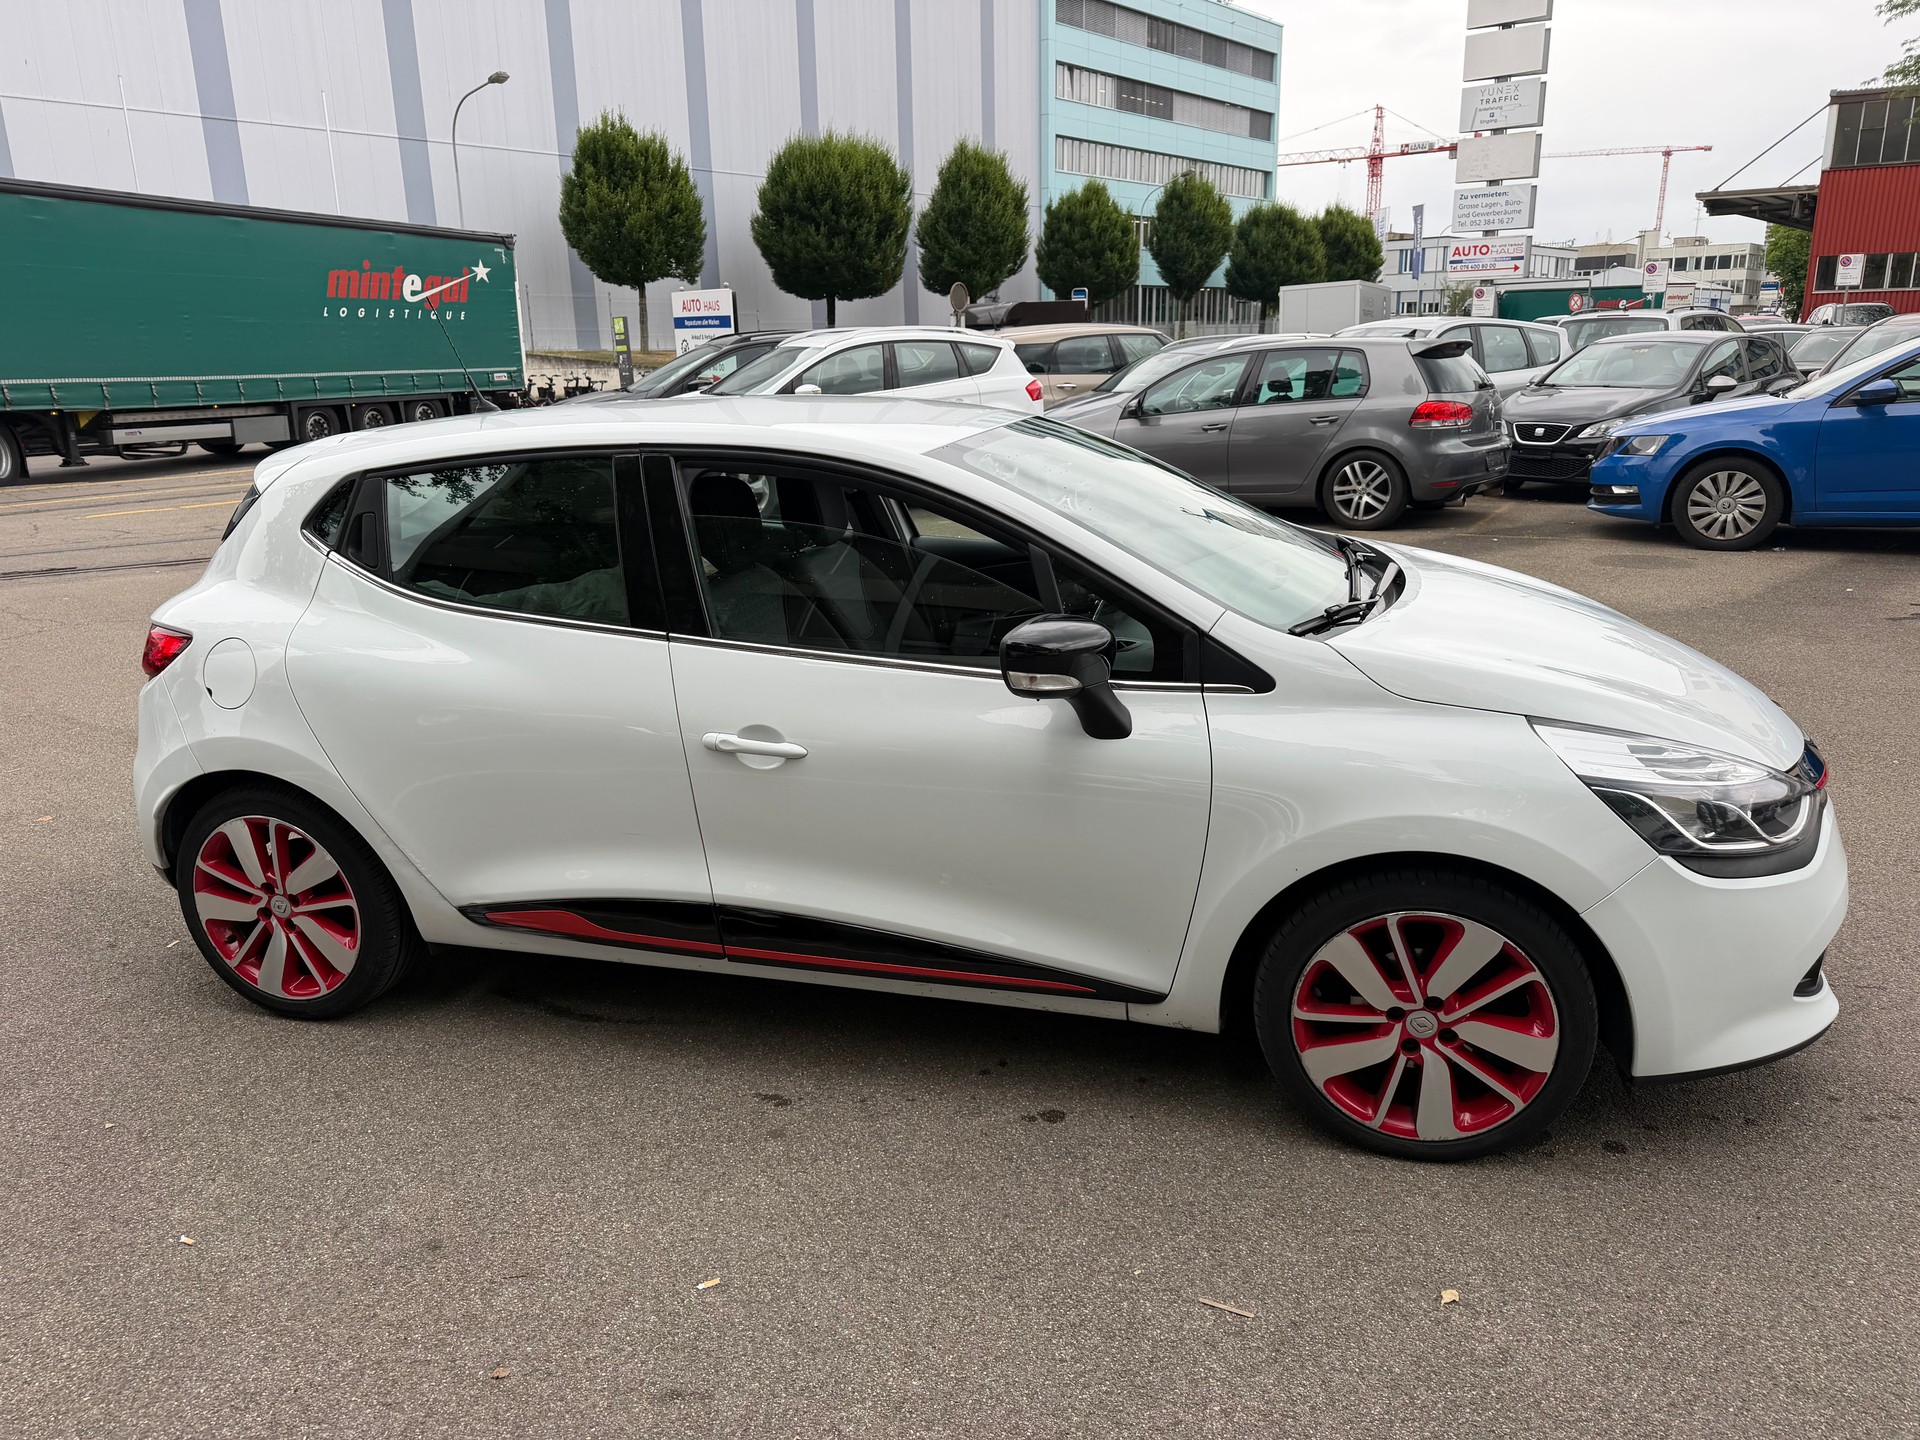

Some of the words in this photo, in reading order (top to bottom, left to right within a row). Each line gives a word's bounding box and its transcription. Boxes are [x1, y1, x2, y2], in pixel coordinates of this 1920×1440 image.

[1480, 84, 1520, 97] YUNEX
[1480, 94, 1519, 105] TRAFFIC
[1470, 191, 1509, 199] vermieten:
[1481, 201, 1503, 209] Lager-,
[1505, 199, 1523, 207] Büro-
[1472, 208, 1522, 218] Gewerberäume
[1470, 219, 1481, 227] 052
[1452, 244, 1490, 257] AUTO
[1490, 246, 1524, 255] HAUS
[327, 259, 470, 310] mintegui
[682, 299, 701, 312] AUTO
[703, 300, 720, 312] HAUS
[323, 307, 466, 320] LOGISTIQUE
